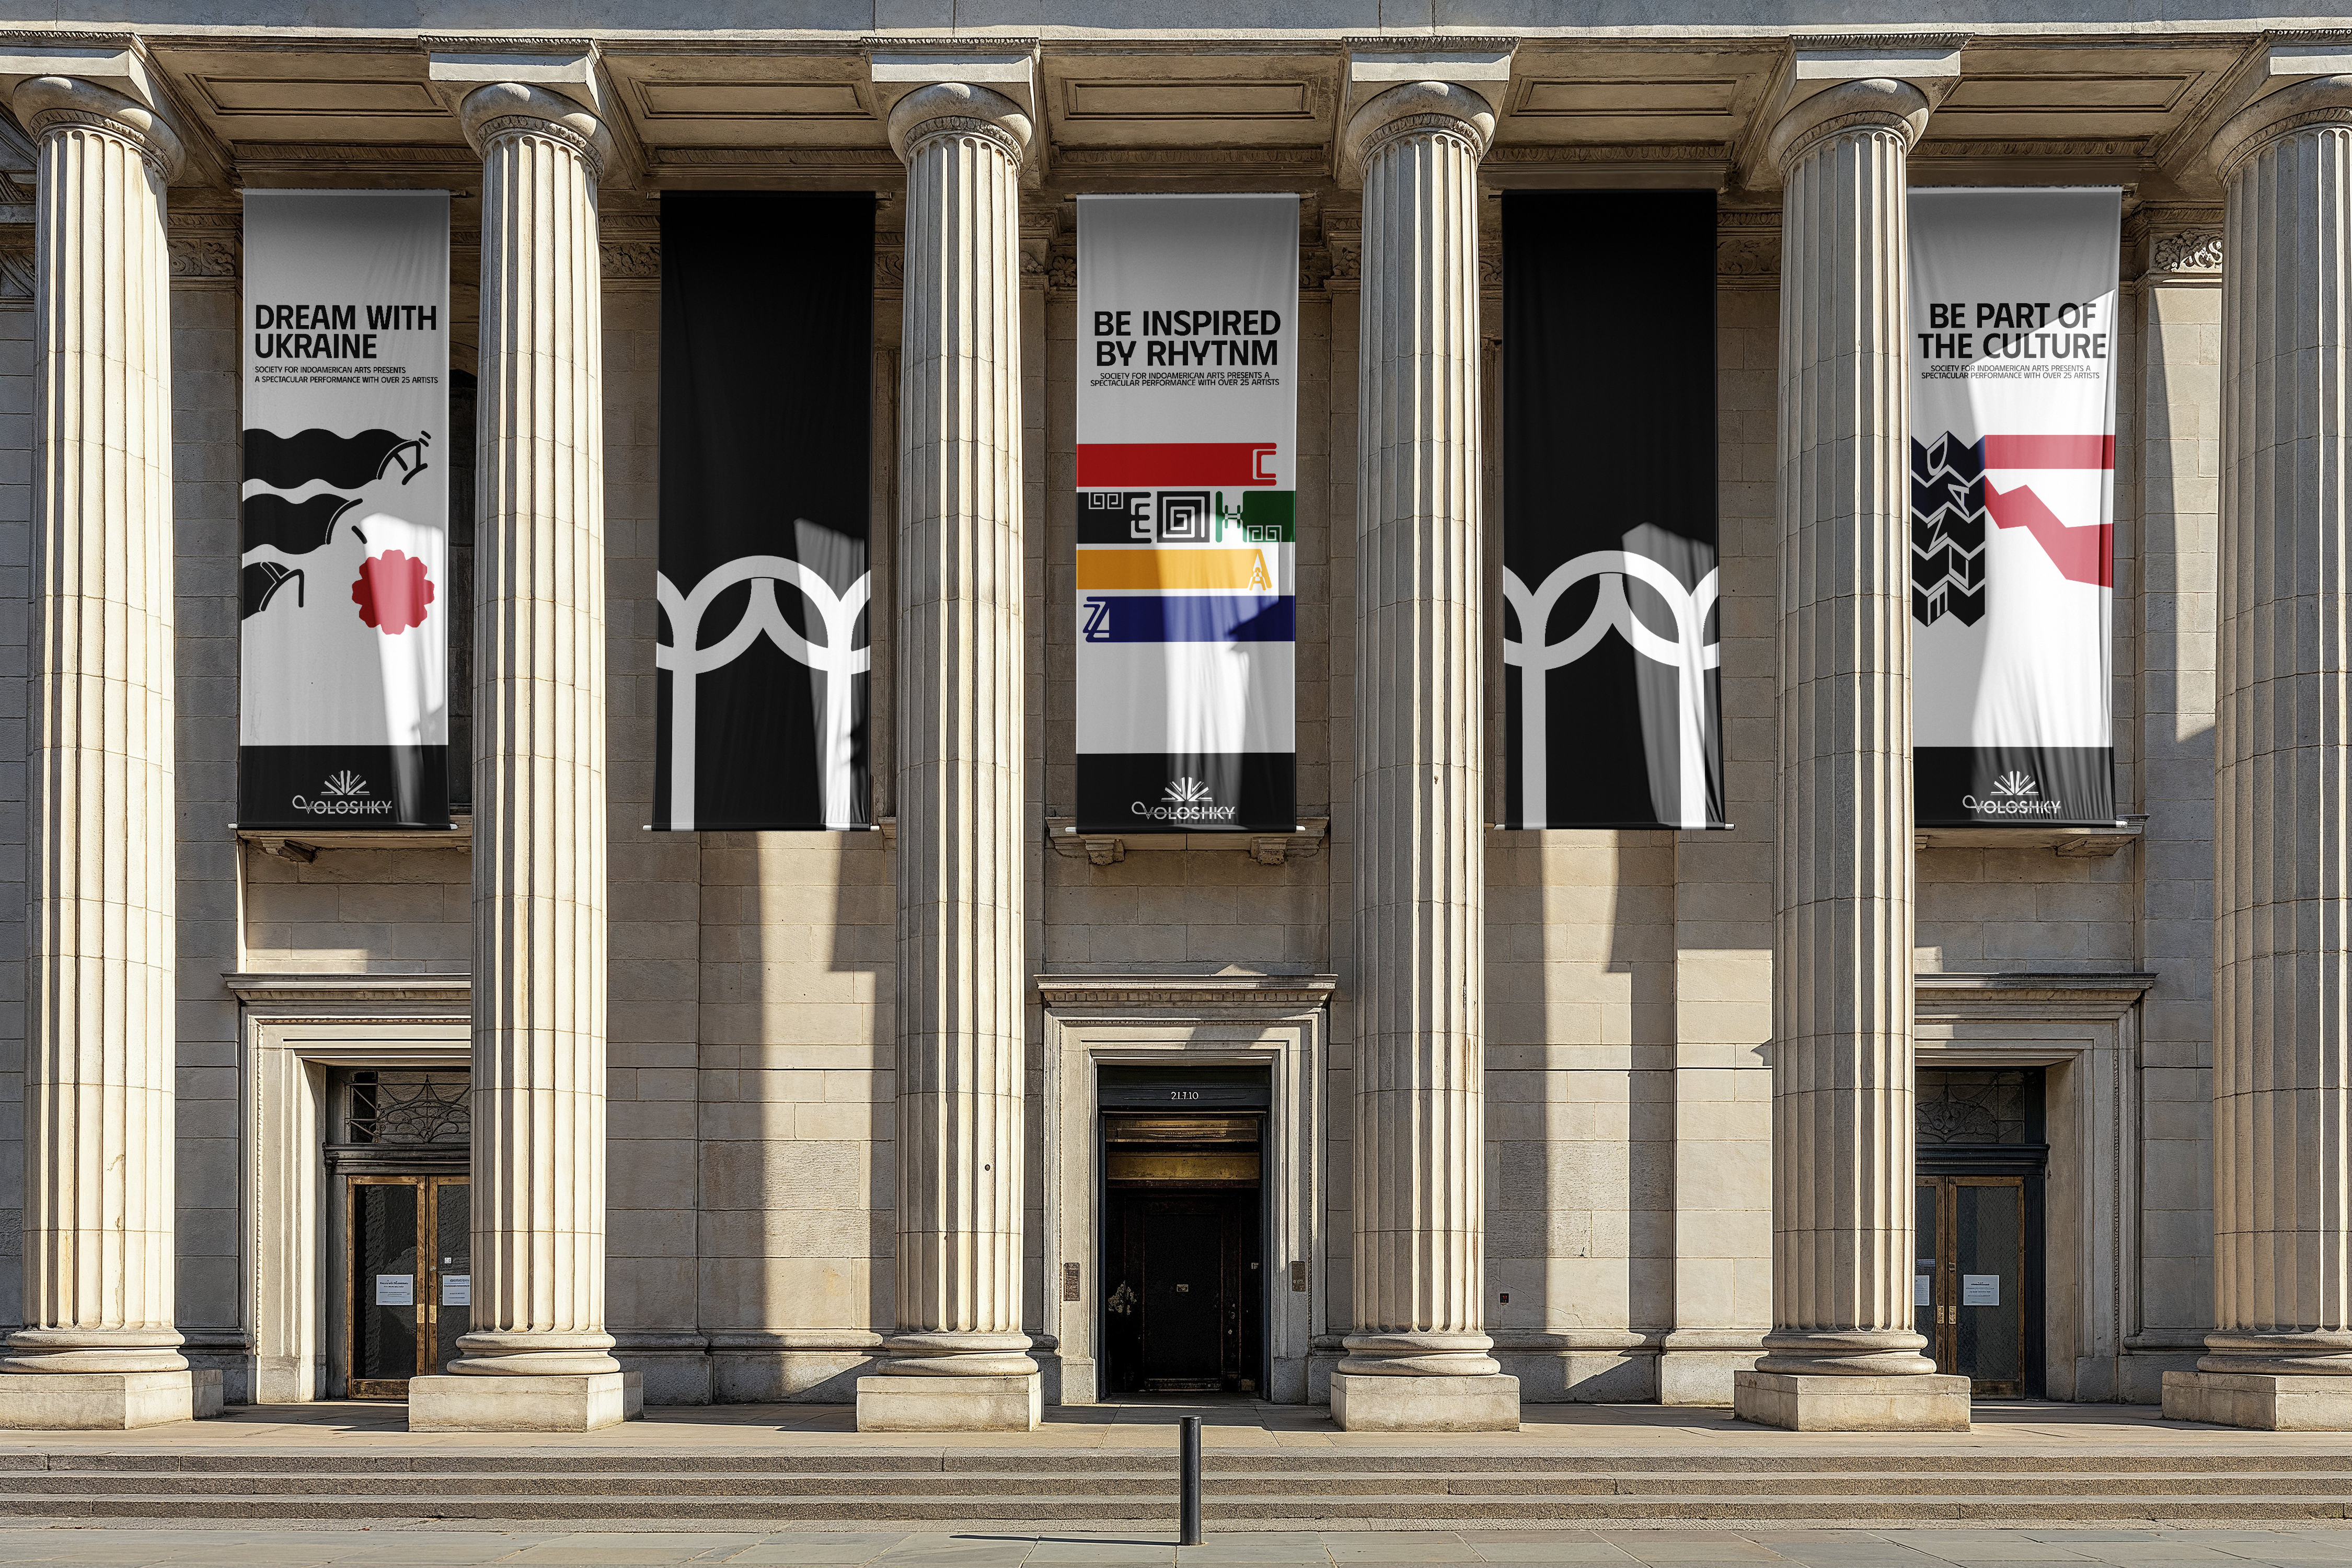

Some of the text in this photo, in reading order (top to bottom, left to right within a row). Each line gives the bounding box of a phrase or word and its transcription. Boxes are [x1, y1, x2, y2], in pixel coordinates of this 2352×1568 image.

[256, 304, 436, 330] DREAM WITH
[1094, 310, 1281, 337] BE INSPIRED
[1930, 303, 2096, 329] BE PART OF
[255, 333, 377, 359] UKRAINE
[1097, 340, 1277, 366] BY RHYTNM
[1918, 332, 2106, 359] THE CULTURE
[292, 795, 393, 814] VOLOSHKY
[1131, 801, 1236, 820] VOLOSHKY
[1962, 795, 2061, 814] VOLOSHKY
